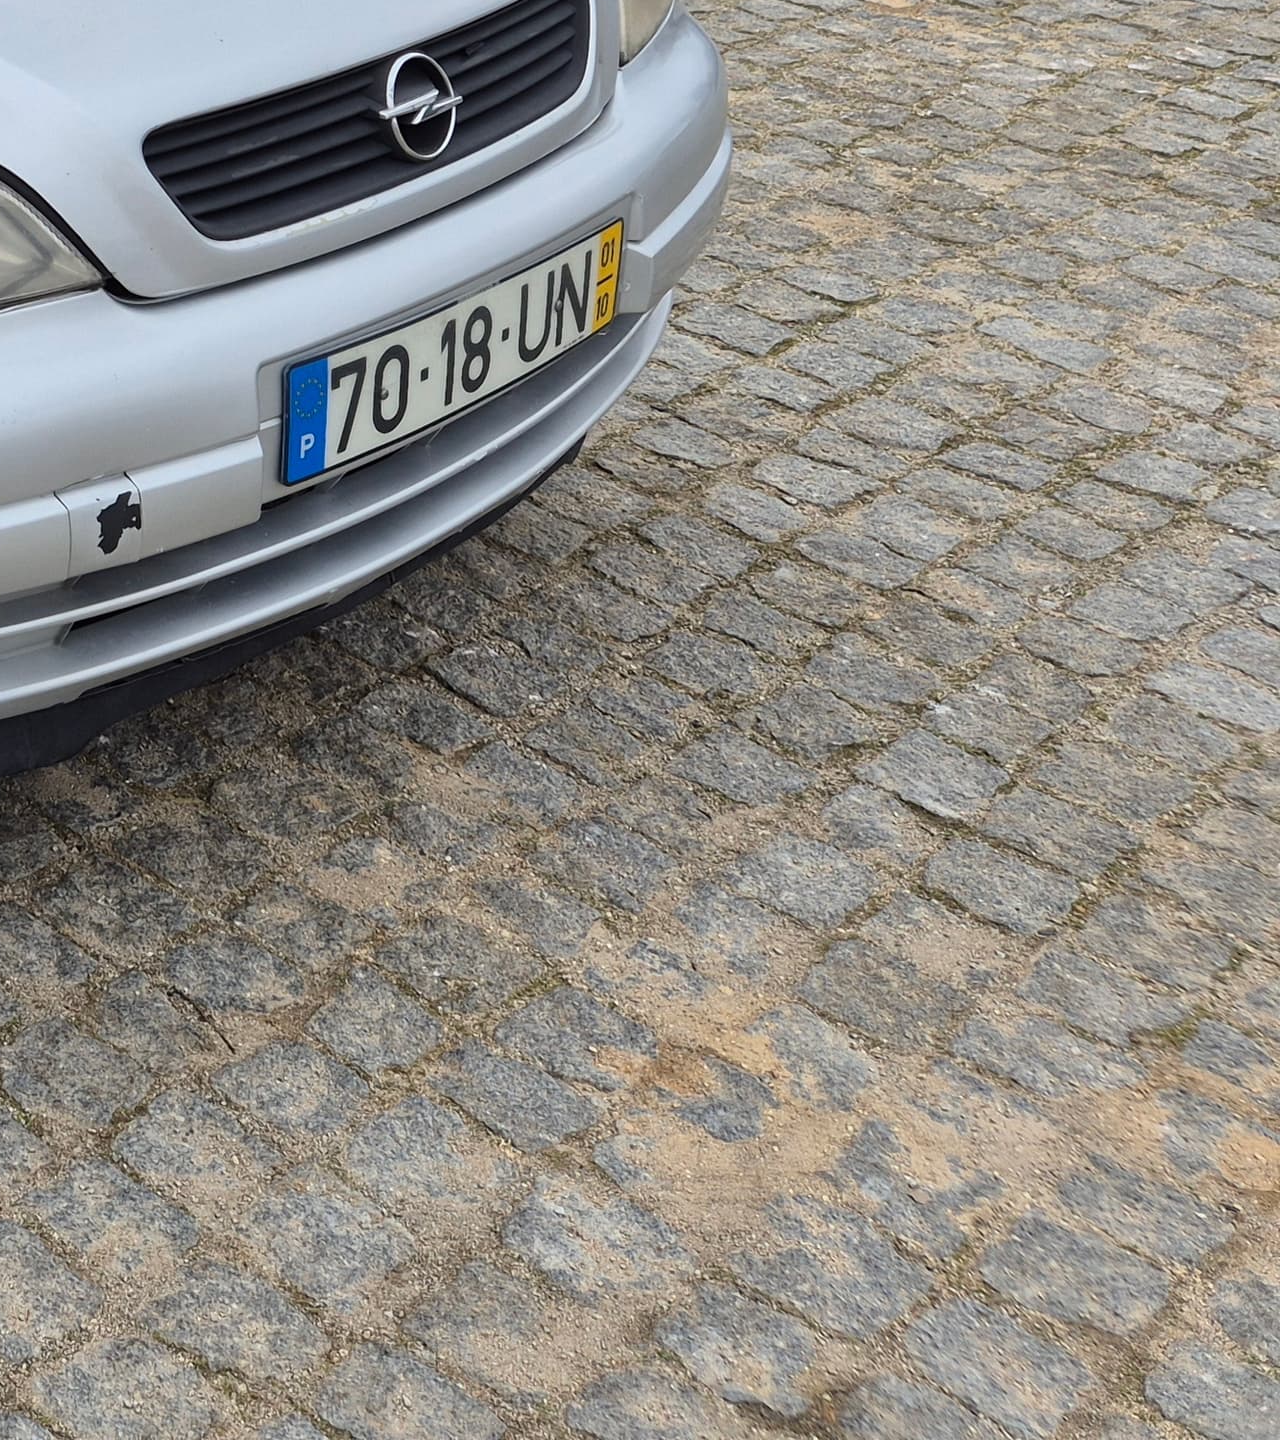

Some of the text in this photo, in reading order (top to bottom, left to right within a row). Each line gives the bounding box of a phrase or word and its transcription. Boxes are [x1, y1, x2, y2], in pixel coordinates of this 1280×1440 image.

[600, 237, 616, 268] 01
[595, 292, 609, 321] 10
[299, 433, 315, 459] P
